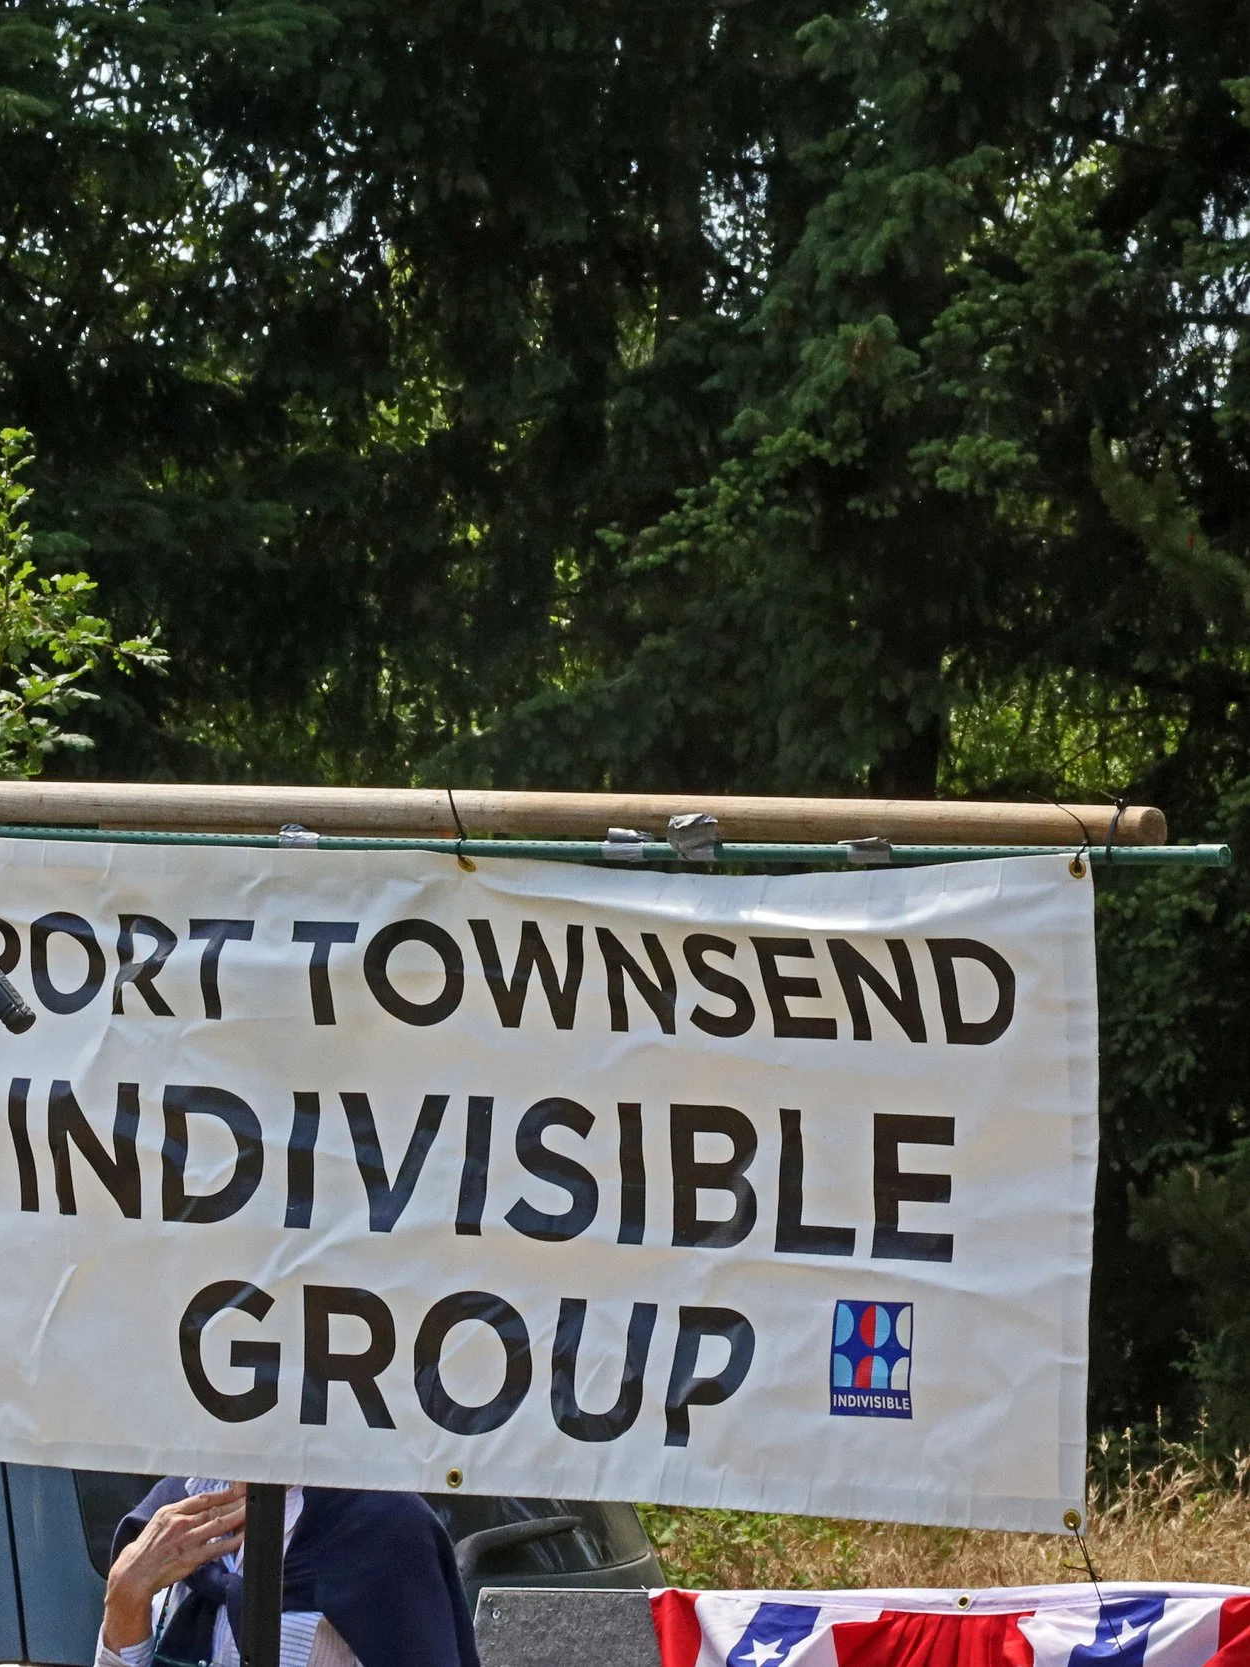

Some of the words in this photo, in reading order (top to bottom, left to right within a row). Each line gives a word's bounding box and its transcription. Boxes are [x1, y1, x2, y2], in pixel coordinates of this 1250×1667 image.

[291, 917, 1016, 1046] TOWNSEND
[6, 1077, 957, 1262] INDIVISIBLE
[177, 1279, 756, 1447] GROUP
[832, 1393, 911, 1411] INDIVISIBLE
